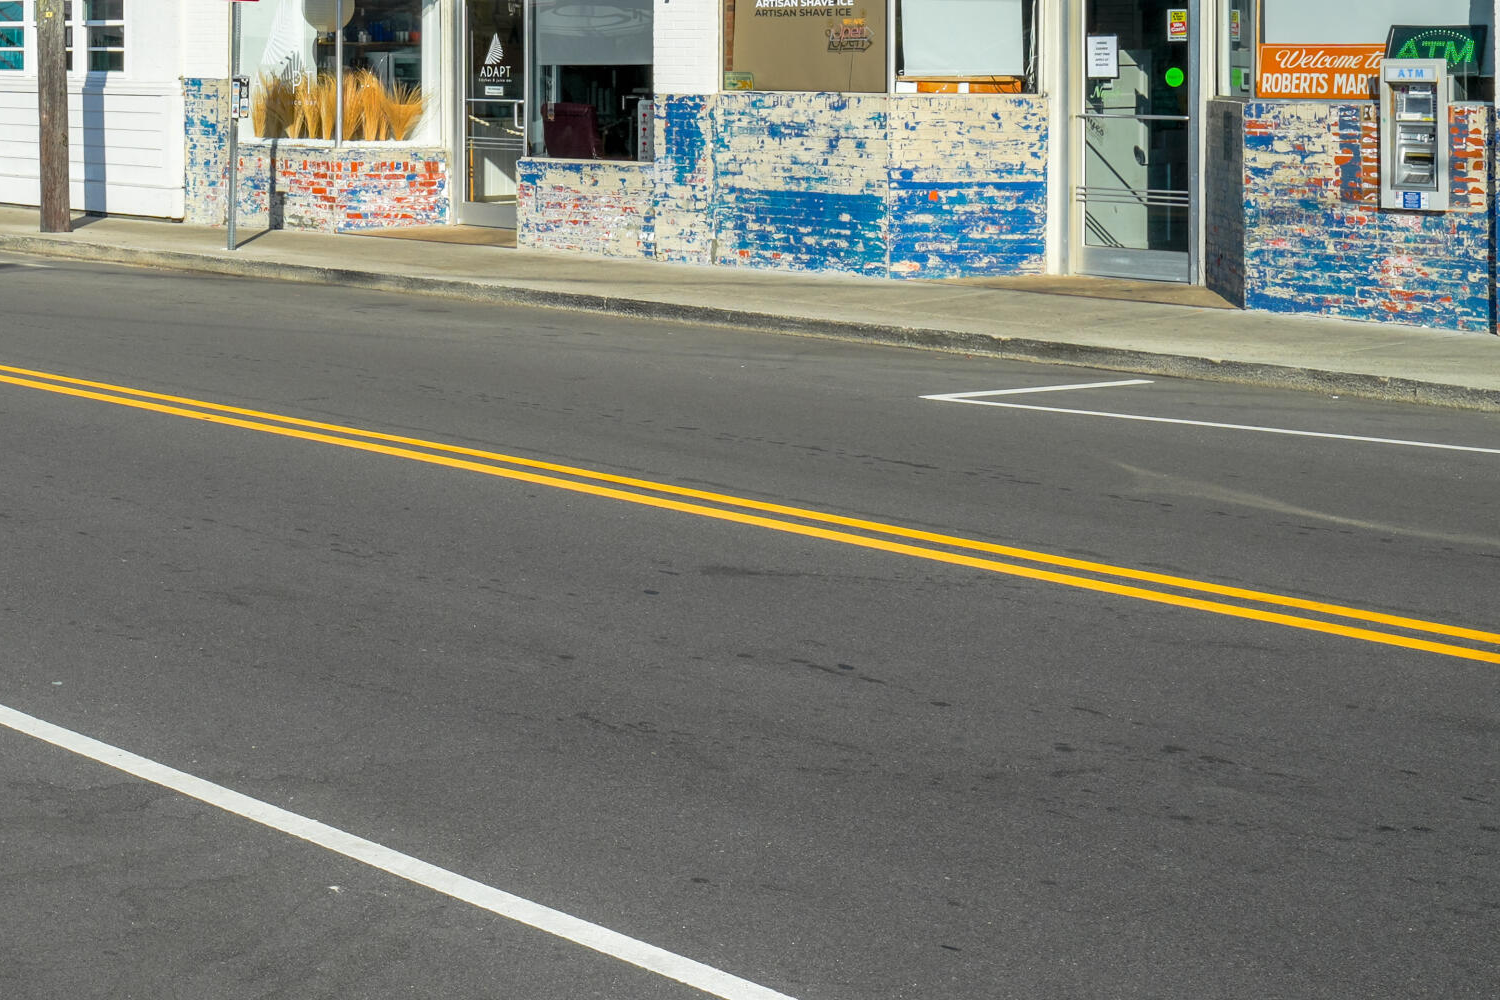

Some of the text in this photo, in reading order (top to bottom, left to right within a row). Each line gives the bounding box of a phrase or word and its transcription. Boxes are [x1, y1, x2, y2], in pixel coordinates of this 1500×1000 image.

[754, 8, 852, 17] ARTISAN SHAVE ICE
[1275, 48, 1385, 69] Welcome to
[1396, 40, 1475, 63] ATM
[252, 71, 315, 94] APT
[480, 66, 511, 78] ADAPT
[1398, 68, 1424, 78] ATM
[1261, 73, 1380, 95] ROBERTS MARK
